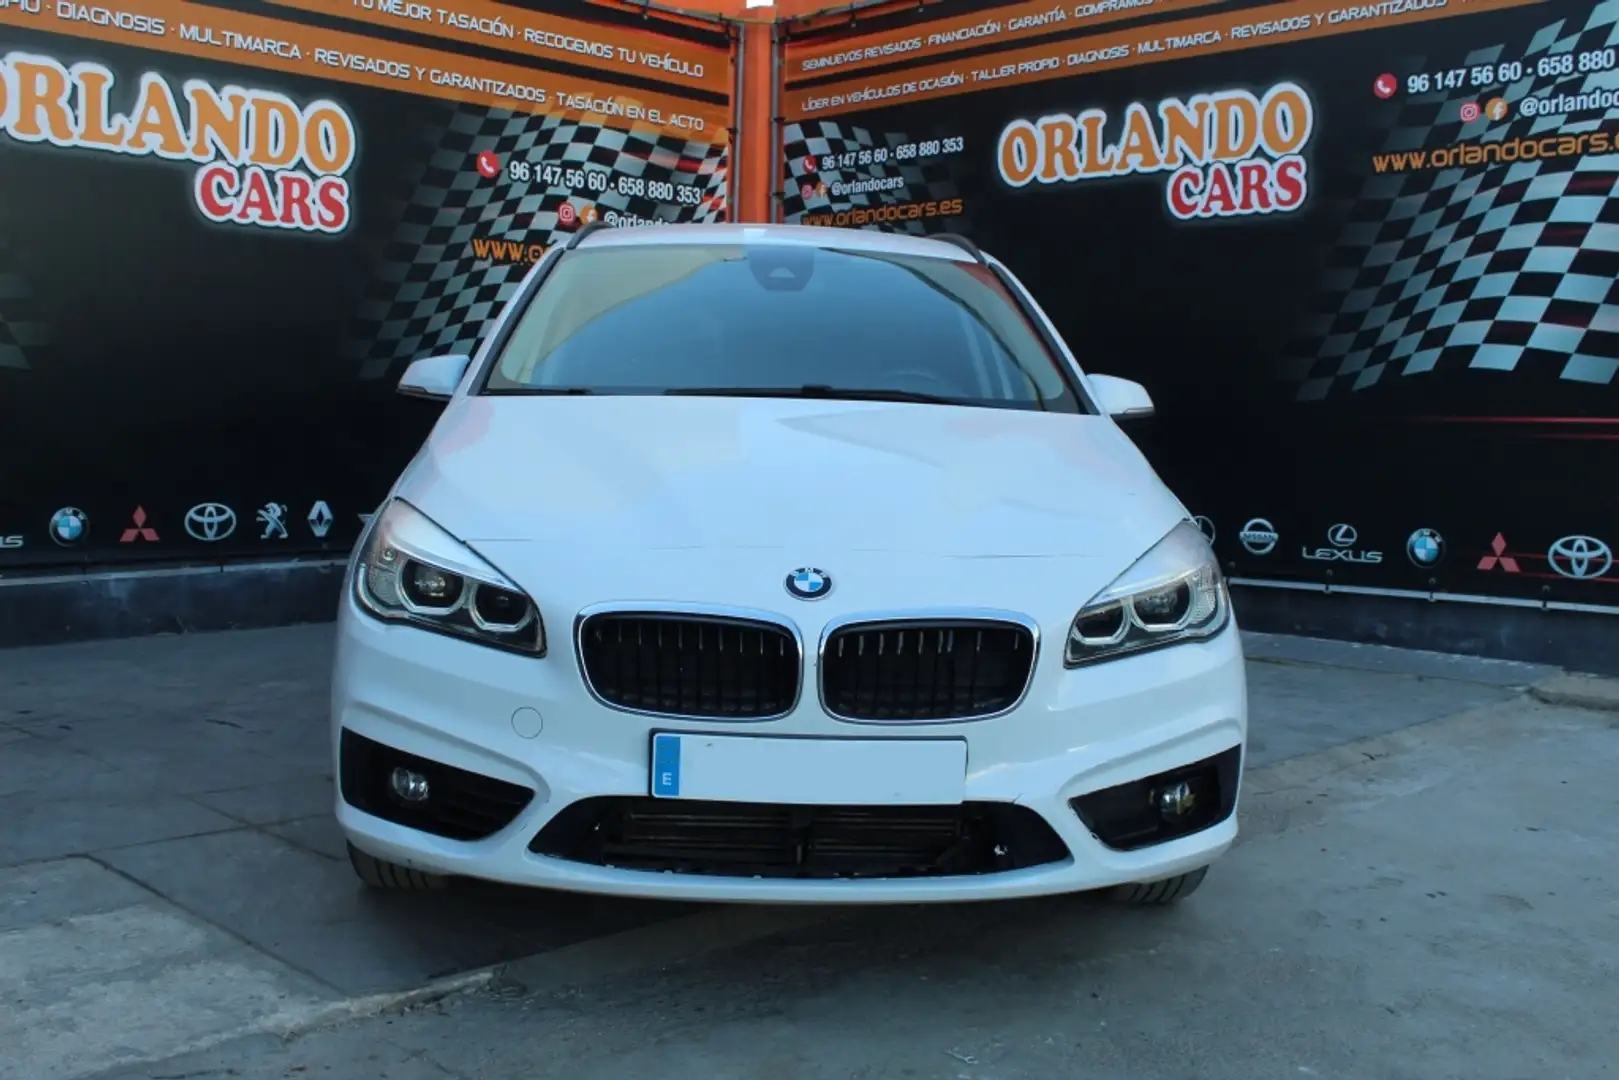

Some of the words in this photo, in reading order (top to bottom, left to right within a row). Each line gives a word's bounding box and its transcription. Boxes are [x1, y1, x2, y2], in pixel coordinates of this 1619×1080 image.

[378, 0, 432, 21] MEJOR
[436, 8, 514, 39] TASACIÓN
[524, 28, 614, 59] RECOGEMOS
[616, 46, 637, 63] TU
[639, 51, 704, 78] VEHÍCULO
[802, 49, 862, 71] SEMINUEVOS
[864, 37, 922, 59] REVISADOS
[927, 19, 1001, 46] FINANCIACIÓN
[1007, 5, 1066, 31] GARANTÍA
[802, 96, 829, 112] LÍDER
[831, 92, 846, 107] EN
[846, 85, 901, 104] VEHÍCULOS
[902, 81, 917, 95] DE
[919, 70, 965, 91] OCASIÓN
[971, 64, 1016, 82] TALLER
[1017, 56, 1061, 75] PROPIO
[1066, 44, 1130, 67] DIAGNOSIS
[1137, 30, 1223, 55] MULTIMARCA
[1231, 15, 1312, 40] REVISADOS
[1314, 13, 1326, 27] Y
[56, 0, 166, 35] DIAGNOSIS
[179, 23, 302, 60] MULTIMARCA
[314, 48, 411, 80] REVISADOS
[414, 66, 426, 82] Y
[429, 69, 546, 103] GARANTIZADOS
[556, 91, 625, 116] TASACIÓN
[626, 104, 646, 121] EN
[648, 108, 667, 125] EL
[669, 113, 704, 132] ACTO
[1407, 73, 1430, 94] 96
[1434, 69, 1466, 90] 147
[1470, 65, 1494, 86] 56
[1498, 61, 1522, 82] 60
[1537, 55, 1573, 77] 658
[1578, 48, 1615, 71] 880
[822, 156, 835, 170] 96
[838, 153, 856, 168] 147
[858, 151, 873, 165] 56
[874, 148, 888, 162] 60
[896, 144, 916, 159] 658
[919, 140, 940, 156] 880
[942, 136, 964, 153] 353
[998, 84, 1311, 186] ORLANDO
[1372, 131, 1619, 173] www.orlandocars.
[196, 162, 348, 232] CARS
[509, 160, 530, 182] 96
[533, 164, 562, 185] 147
[565, 169, 585, 189] 56
[588, 171, 607, 192] 60
[617, 176, 645, 197] 658
[648, 181, 673, 201] 880
[676, 184, 701, 205] 353
[832, 176, 904, 196] @orlandocars
[1167, 156, 1305, 219] CARS
[1302, 546, 1383, 563] LEXUS
[662, 771, 673, 786] E
